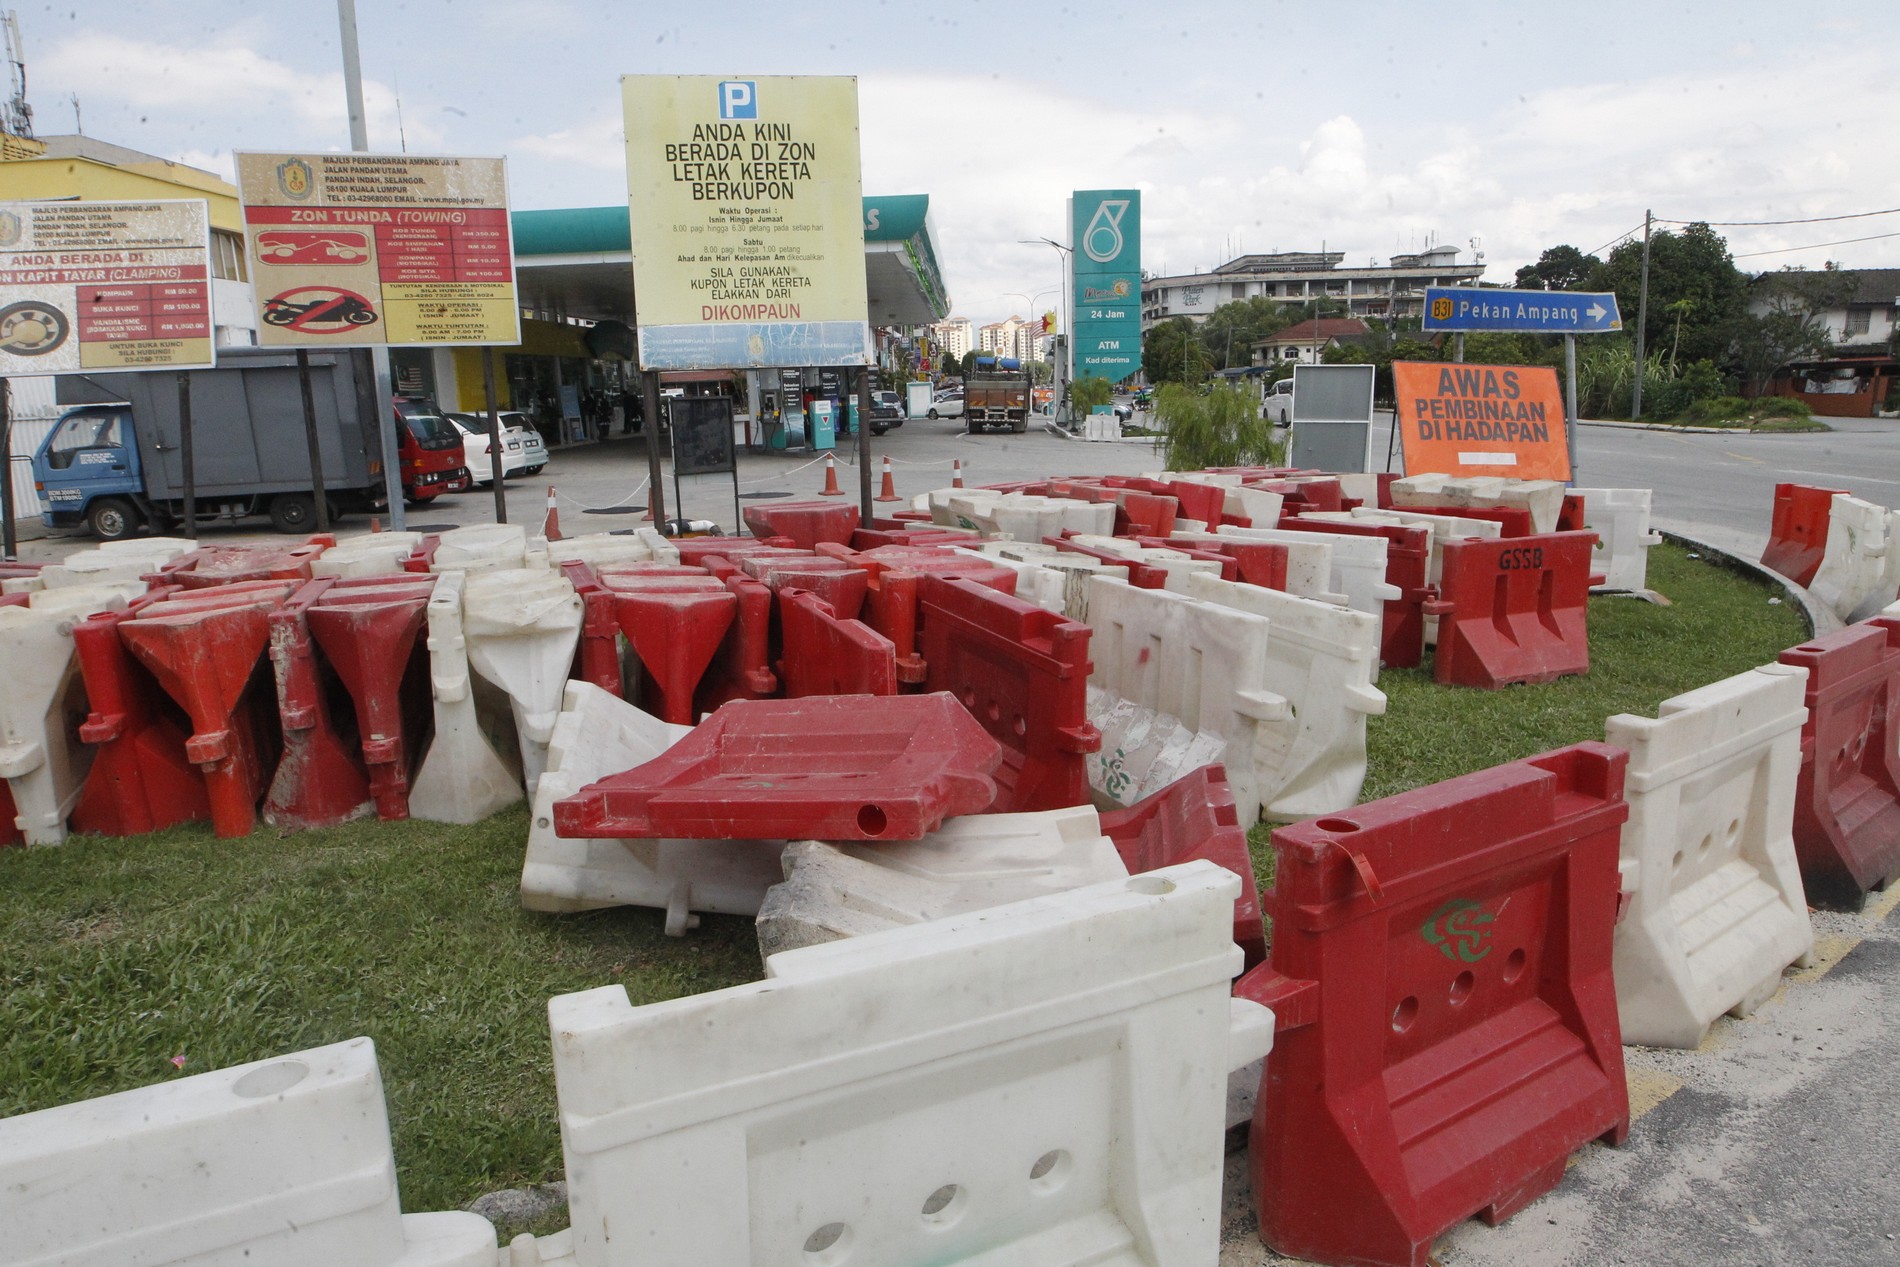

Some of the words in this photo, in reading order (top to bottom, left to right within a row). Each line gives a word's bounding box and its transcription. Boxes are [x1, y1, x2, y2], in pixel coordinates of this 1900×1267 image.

[726, 83, 750, 117] P
[693, 124, 745, 141] ANDA
[755, 124, 791, 141] KINI
[666, 144, 742, 162] BERADA
[752, 144, 769, 160] DI
[778, 143, 815, 160] ZON
[673, 163, 730, 182] LETAK
[741, 163, 811, 180] KERETA
[692, 182, 794, 200] BERKUPON
[292, 210, 328, 222] ZON
[333, 211, 392, 222] TUNDA
[397, 212, 466, 225] (TOWING)
[745, 207, 770, 215] Operasi
[730, 216, 754, 224] Hingga
[690, 225, 704, 234] pagi
[708, 225, 728, 234] hingga
[749, 225, 770, 233] petang
[721, 246, 734, 254] pagi
[738, 246, 758, 254] hingga
[779, 246, 800, 254] petang
[11, 256, 54, 266] ANDA
[60, 253, 123, 264] BERADA
[129, 252, 143, 262] DI
[734, 254, 770, 262] Kelepasan
[16, 271, 58, 282] KAPIT
[62, 269, 106, 281] TAYAR
[110, 267, 181, 282] (CLAMPING)
[710, 268, 733, 278] SILA
[740, 266, 790, 276] GUNAKAN
[690, 279, 727, 290] KUPON
[734, 278, 766, 288] LETAK
[772, 277, 811, 288] KERETA
[712, 289, 760, 300] ELAKKAN
[766, 288, 791, 299] DARI
[701, 304, 800, 320] DIKOMPAUN
[1091, 310, 1102, 318] 24
[1106, 310, 1124, 318] Jam
[1434, 300, 1451, 316] B31
[1460, 302, 1510, 318] Pekan
[1516, 304, 1578, 324] Ampang
[1098, 341, 1120, 350] ATM
[1438, 368, 1520, 399] AWAS
[1416, 398, 1545, 422] PEMBINAAN
[1418, 420, 1441, 440] DI
[1446, 420, 1548, 442] HADAPAN
[1500, 548, 1542, 570] GSSB
